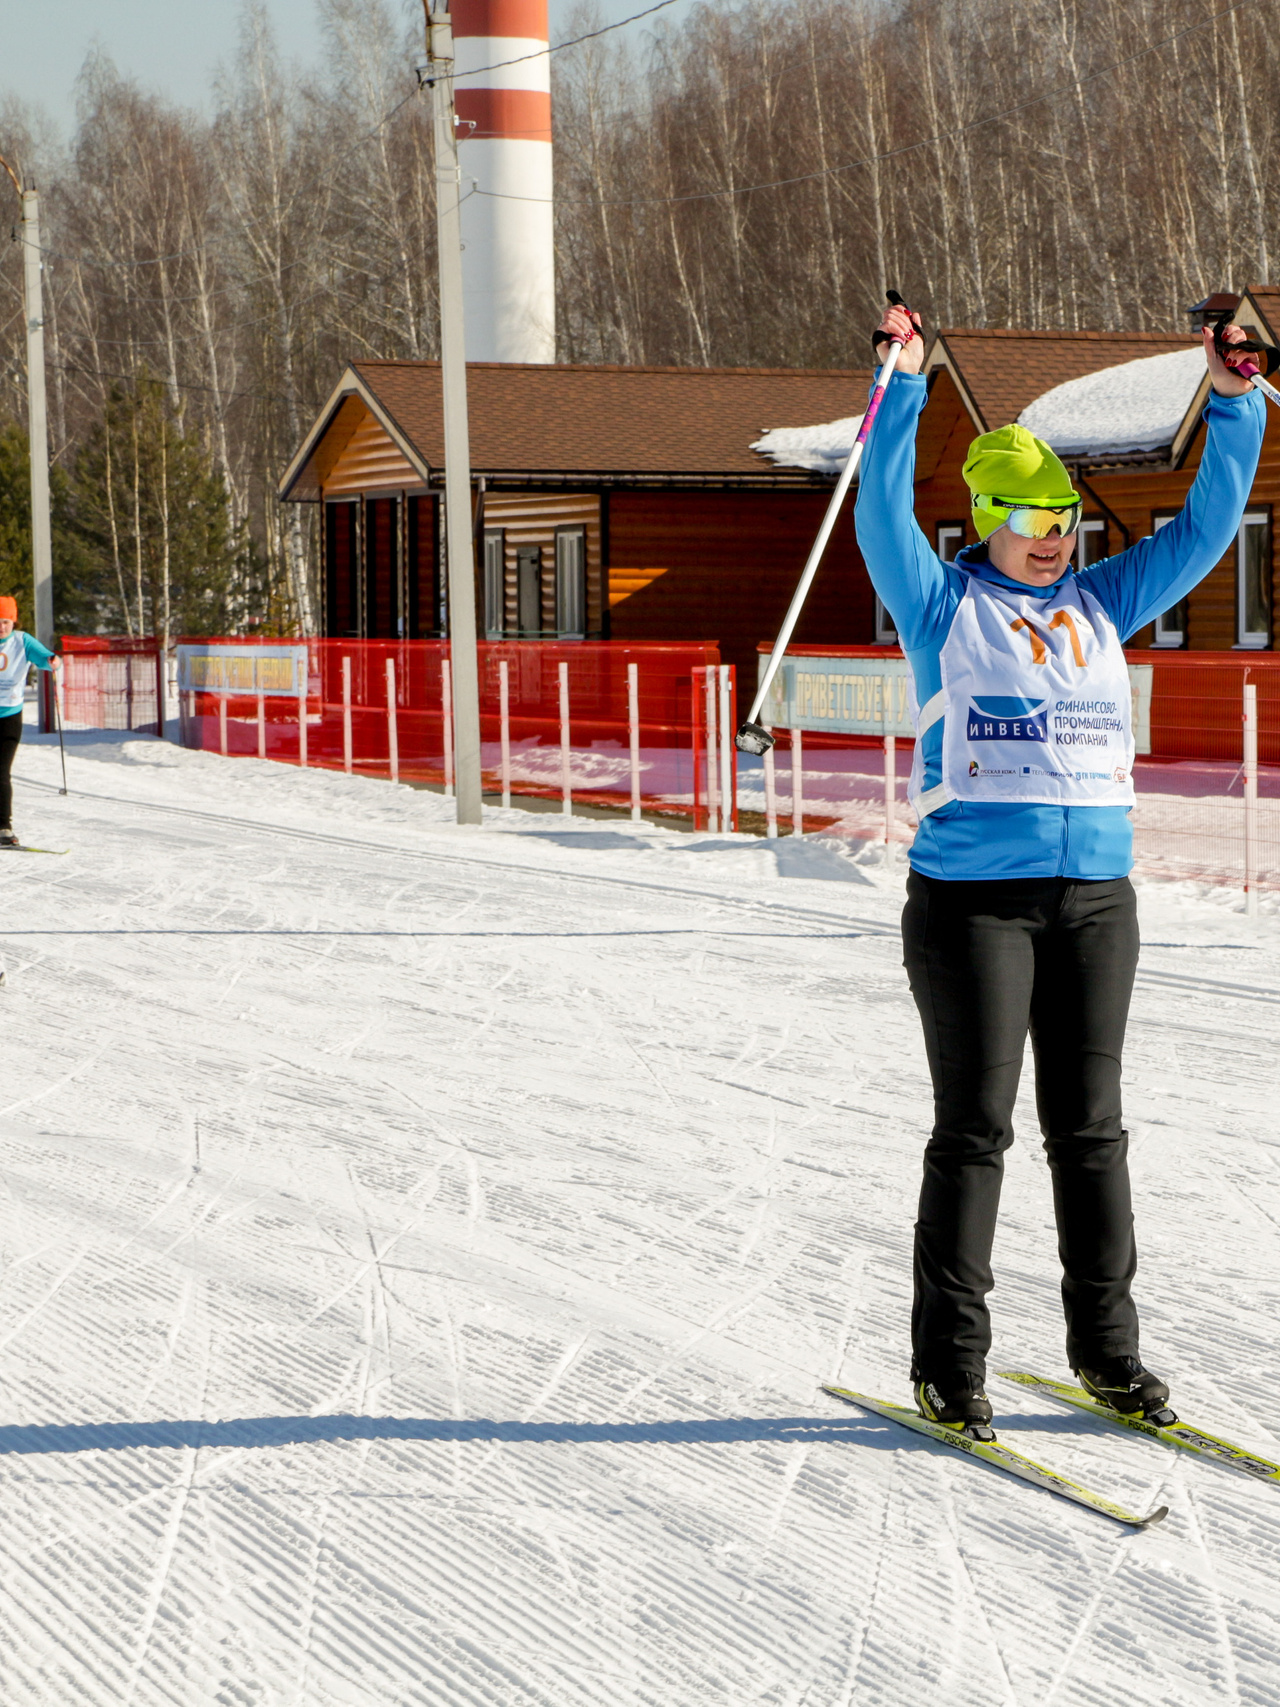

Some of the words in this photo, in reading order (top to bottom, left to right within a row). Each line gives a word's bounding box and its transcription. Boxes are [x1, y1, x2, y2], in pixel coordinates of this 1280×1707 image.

[797, 672, 893, 723] ПРИВЕТСТВУЕМ
[1055, 700, 1118, 714] ФИНАНСОВО-
[1054, 716, 1124, 732] ПРОМЫШЛЕННА
[1055, 733, 1108, 747] КОМПАНИЯ
[926, 1383, 946, 1413] FISCHER
[1128, 1419, 1159, 1438] FISCHER
[944, 1431, 972, 1452] FISCHER
